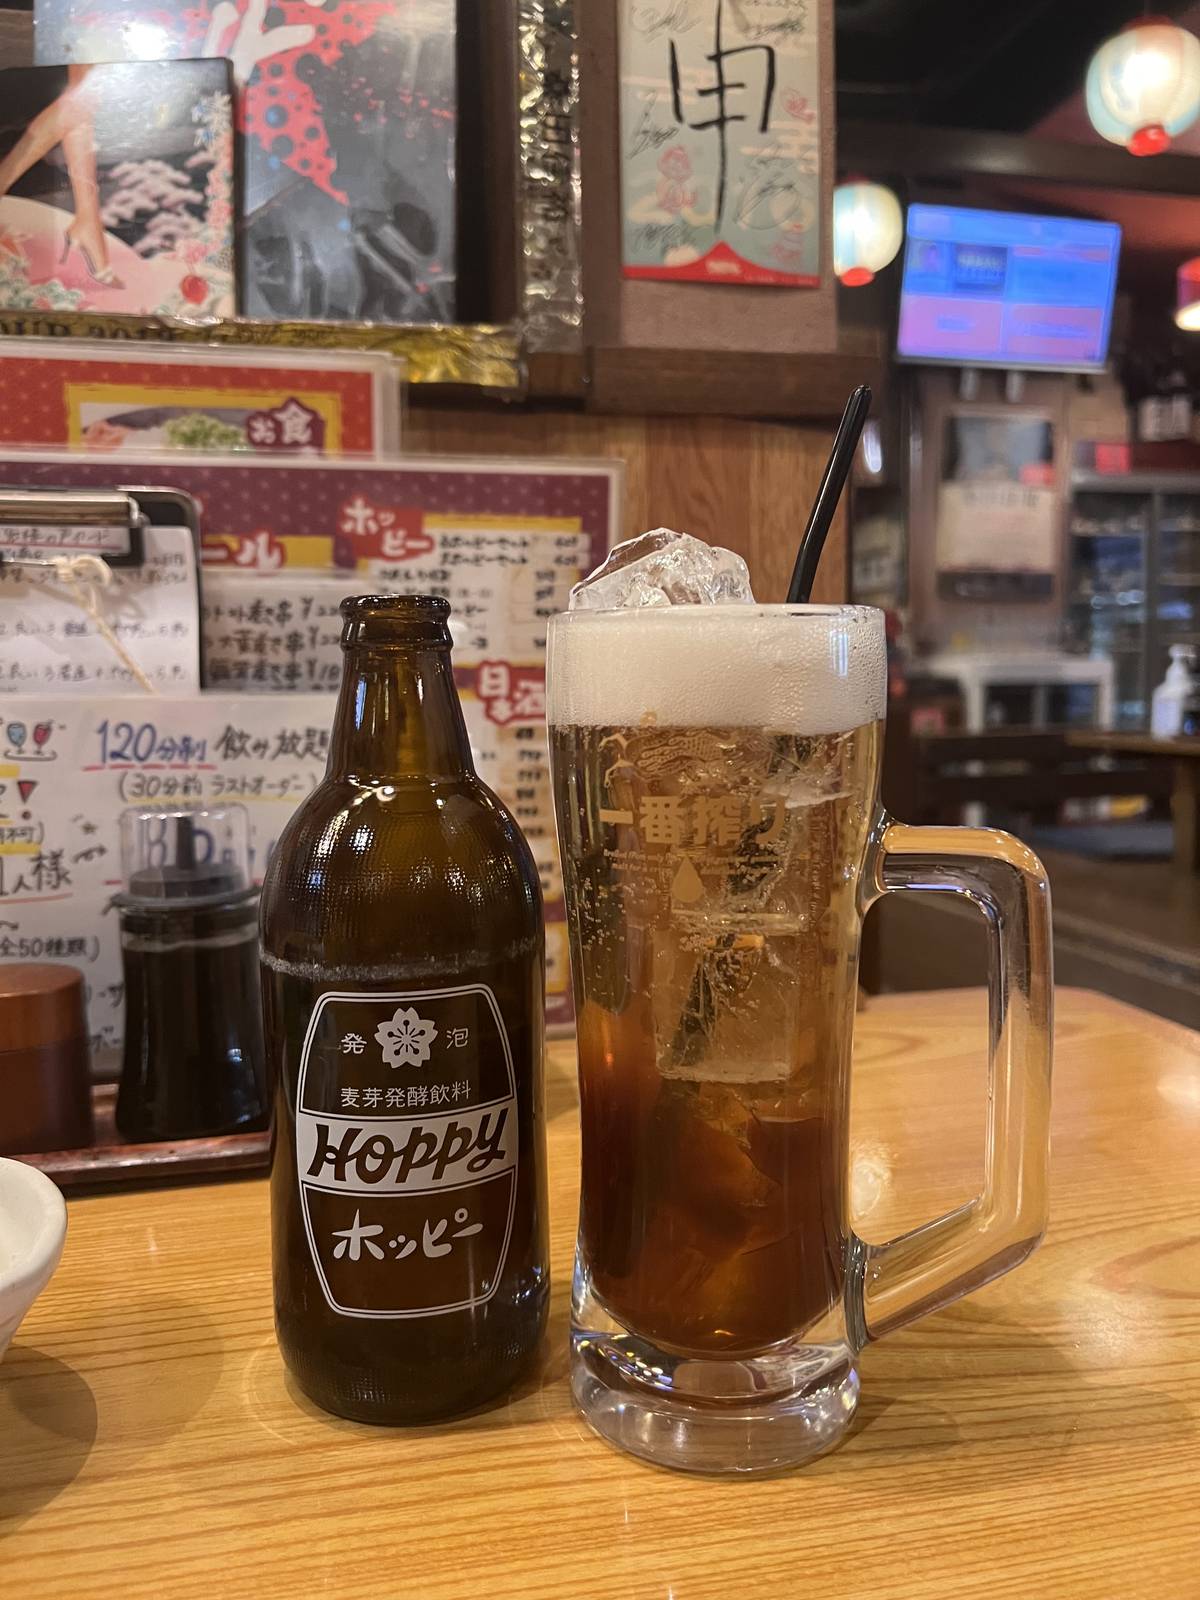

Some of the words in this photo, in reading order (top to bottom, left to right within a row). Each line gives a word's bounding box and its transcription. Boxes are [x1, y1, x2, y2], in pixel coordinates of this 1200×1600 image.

[97, 719, 206, 763] 120分制
[340, 1032, 368, 1055] 発
[446, 1027, 469, 1050] 泡
[340, 1080, 472, 1108] 麦芽発酵飲料
[306, 1107, 511, 1185] Hoppy
[330, 1207, 484, 1262] ホッピー
